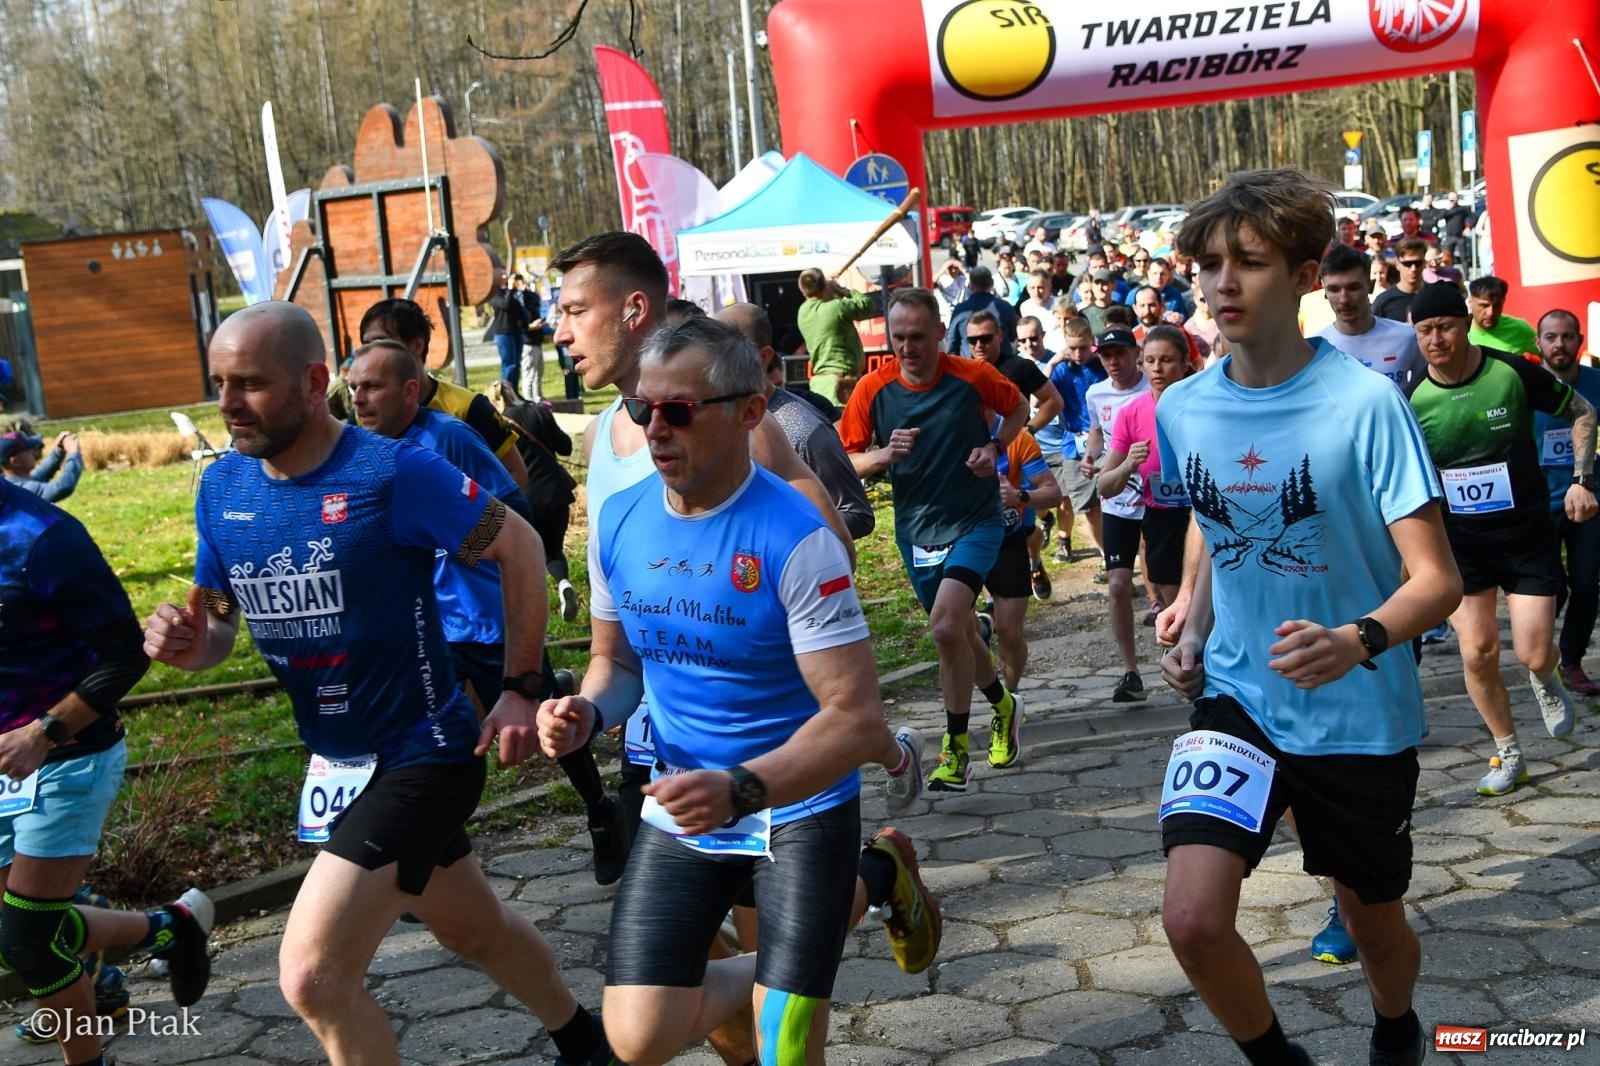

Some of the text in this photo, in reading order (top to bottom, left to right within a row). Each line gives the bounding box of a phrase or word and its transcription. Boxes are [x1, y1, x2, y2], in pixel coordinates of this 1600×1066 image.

[1081, 0, 1332, 50] TWARDZIELA
[1107, 43, 1308, 89] RACIBÓRZ
[1457, 482, 1495, 502] 107
[233, 575, 340, 615] SILESIAN
[304, 616, 341, 638] TEAM
[677, 598, 747, 627] Malibu
[638, 629, 713, 652] TEAM
[1172, 760, 1250, 797] 007
